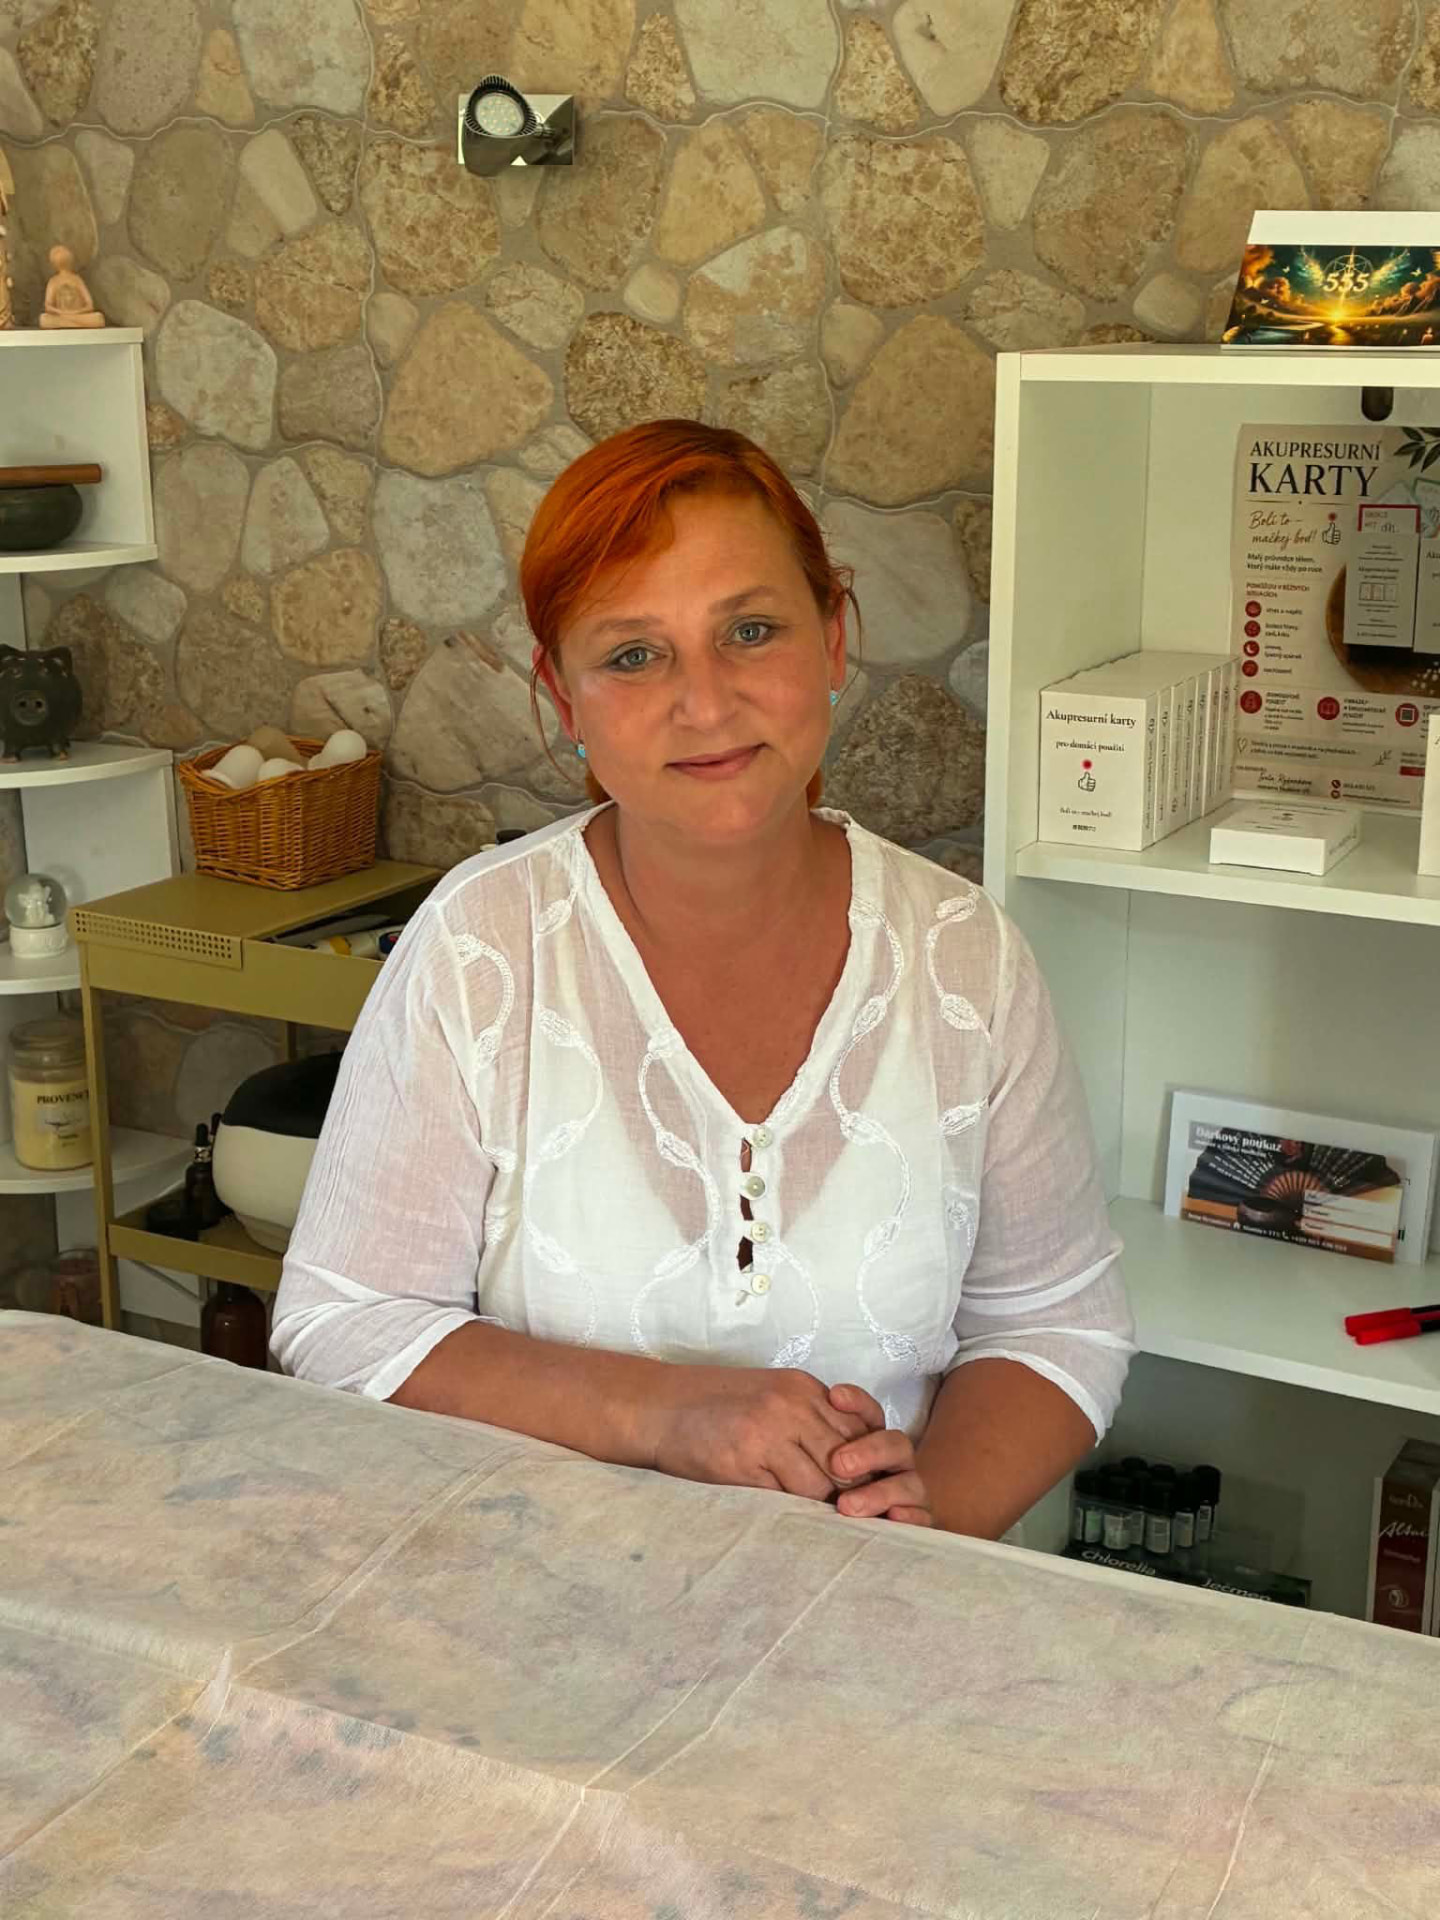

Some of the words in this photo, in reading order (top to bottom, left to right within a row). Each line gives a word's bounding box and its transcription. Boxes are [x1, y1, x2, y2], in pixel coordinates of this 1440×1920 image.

[1323, 272, 1370, 292] 555
[1250, 440, 1383, 461] AKUPRESURNÍ
[1249, 462, 1379, 497] KARTY
[1046, 710, 1109, 724] Akupresurní
[1110, 713, 1137, 729] karty
[1242, 1136, 1282, 1152] poukaz
[1081, 1550, 1156, 1576] Chlorella
